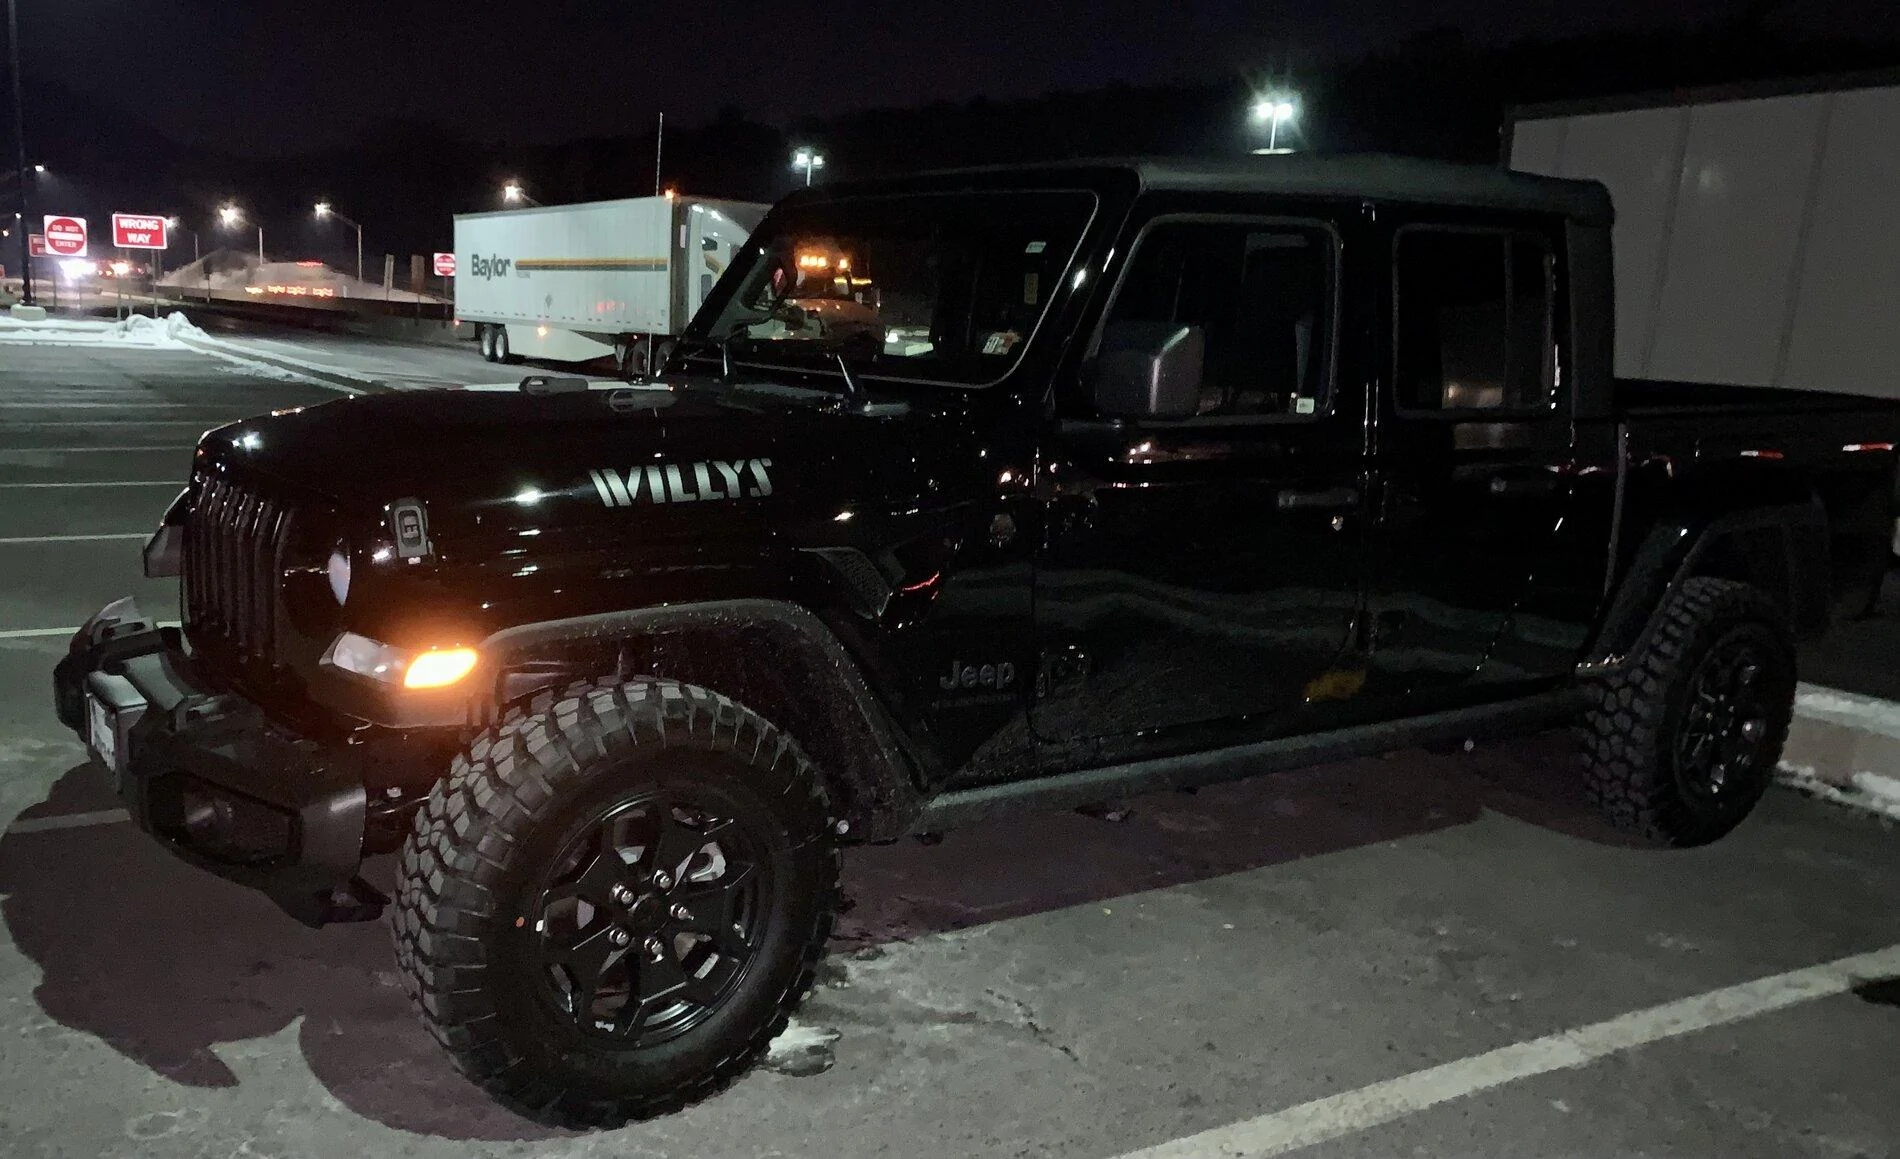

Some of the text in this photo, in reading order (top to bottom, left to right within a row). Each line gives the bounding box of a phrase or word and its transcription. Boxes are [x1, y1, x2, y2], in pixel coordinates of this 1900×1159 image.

[119, 218, 159, 231] WRONG
[55, 240, 77, 248] ENTER
[127, 233, 152, 244] WAY
[471, 253, 511, 281] Baylor
[588, 458, 773, 507] WILLYS
[939, 660, 1015, 690] Jeep
